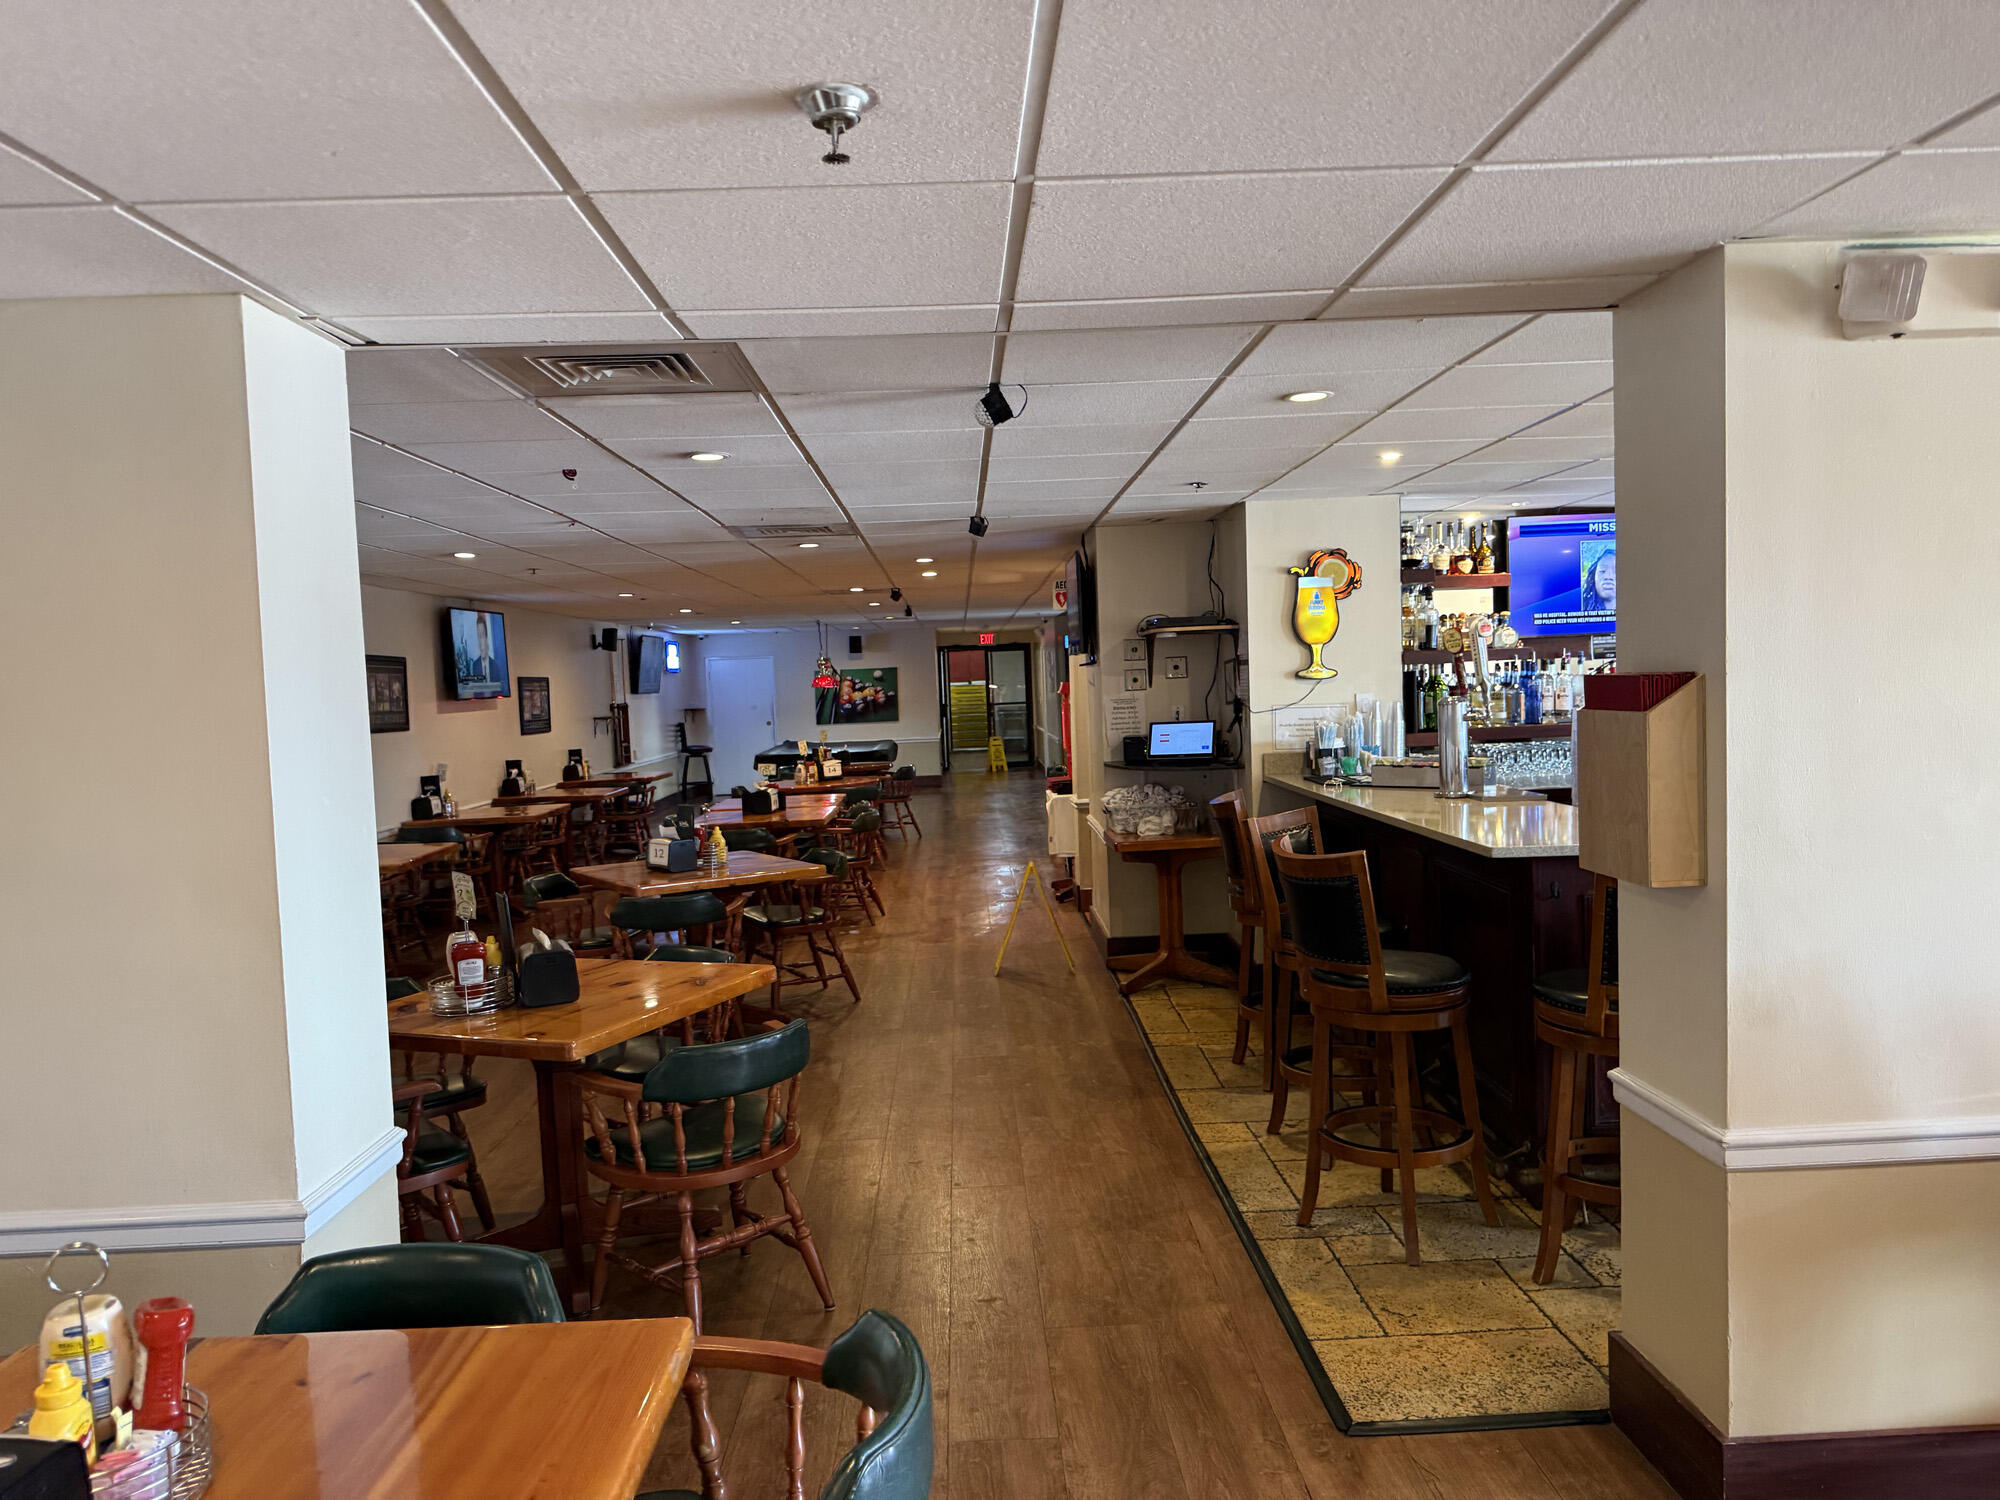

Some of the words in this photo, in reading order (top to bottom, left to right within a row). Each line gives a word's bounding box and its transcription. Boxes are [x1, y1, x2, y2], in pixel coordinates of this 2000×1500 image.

[1588, 523, 1616, 532] MISS
[980, 633, 994, 645] EXIT
[654, 848, 664, 858] 12
